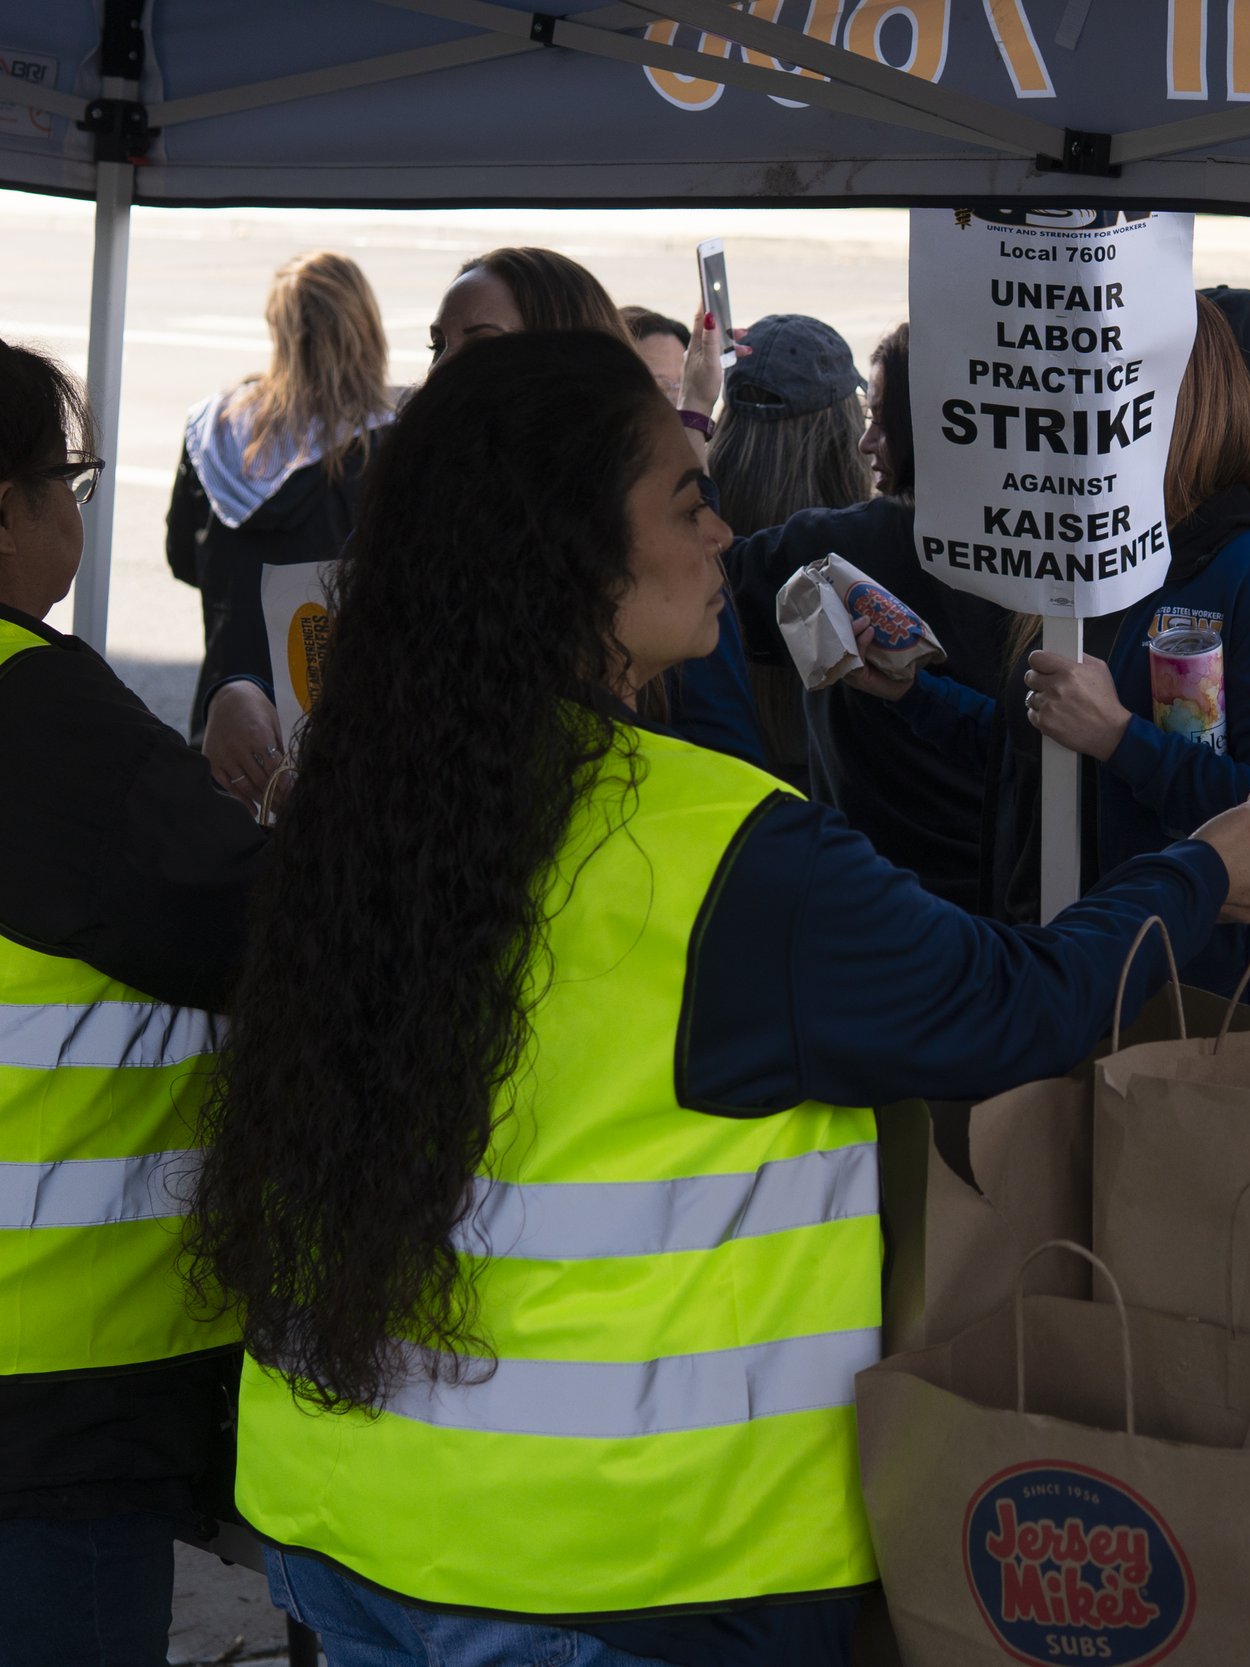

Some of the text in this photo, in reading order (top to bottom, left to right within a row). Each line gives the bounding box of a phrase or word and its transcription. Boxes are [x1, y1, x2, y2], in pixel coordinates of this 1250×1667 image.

[986, 222, 1147, 239] UNITY AND STRENGTH FOR WORKERS
[1000, 241, 1116, 263] Local 7600
[991, 278, 1125, 312] UNFAIR
[996, 321, 1124, 354] LABOR
[969, 359, 1143, 395] PRACTICE
[941, 390, 1155, 456] STRIKE
[1002, 472, 1118, 496] AGAINST
[983, 504, 1131, 543] KAISER
[922, 520, 1165, 582] PERMANENTE
[301, 617, 317, 664] STRENGTH
[1023, 1483, 1100, 1504] SINCE 1956
[986, 1498, 1152, 1586] Jersey
[1001, 1560, 1160, 1630] Mike's
[1045, 1634, 1112, 1658] SUBS
